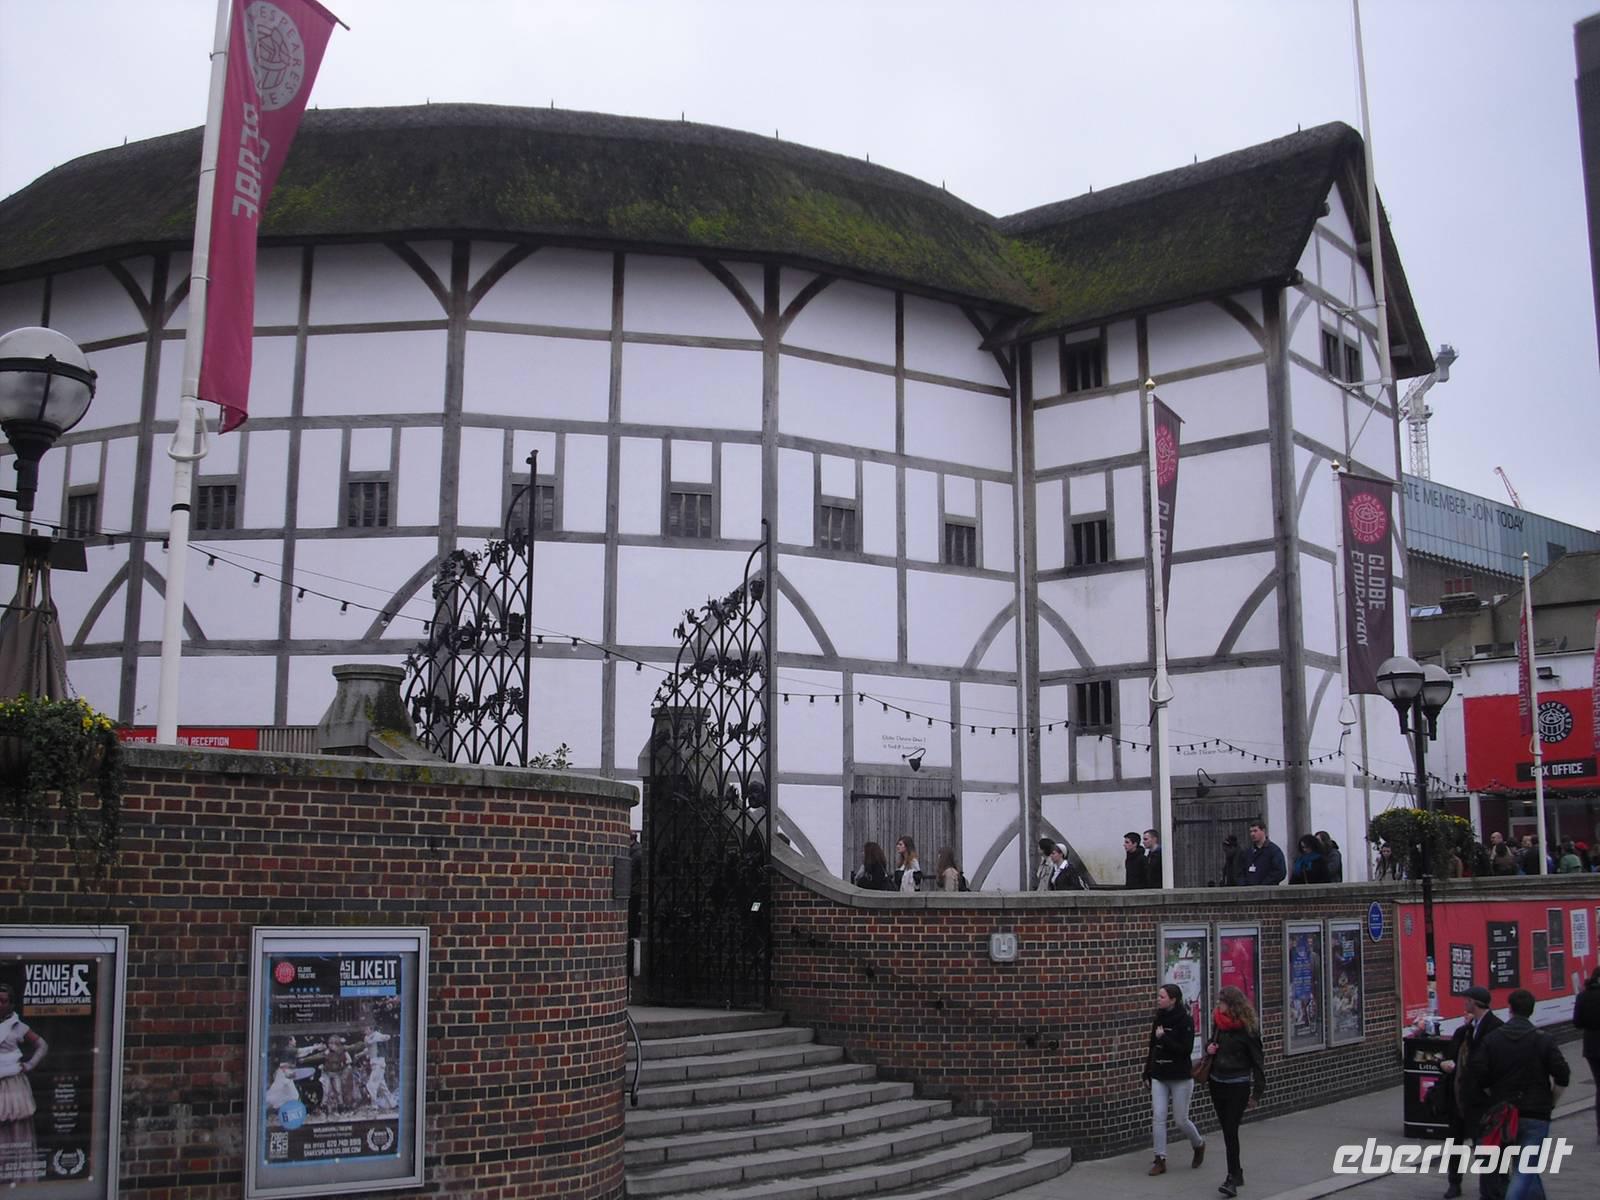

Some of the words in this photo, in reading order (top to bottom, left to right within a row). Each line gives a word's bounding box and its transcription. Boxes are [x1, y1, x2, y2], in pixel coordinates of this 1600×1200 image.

[1495, 509, 1525, 533] TODAY
[1368, 553, 1386, 611] GLOBE
[190, 736, 230, 747] RECEPTION
[1531, 766, 1550, 777] BX
[1552, 762, 1584, 776] OFFICE
[340, 960, 350, 972] AS
[25, 964, 70, 980] VENUS
[69, 964, 92, 996] &
[23, 981, 69, 996] ADONIS
